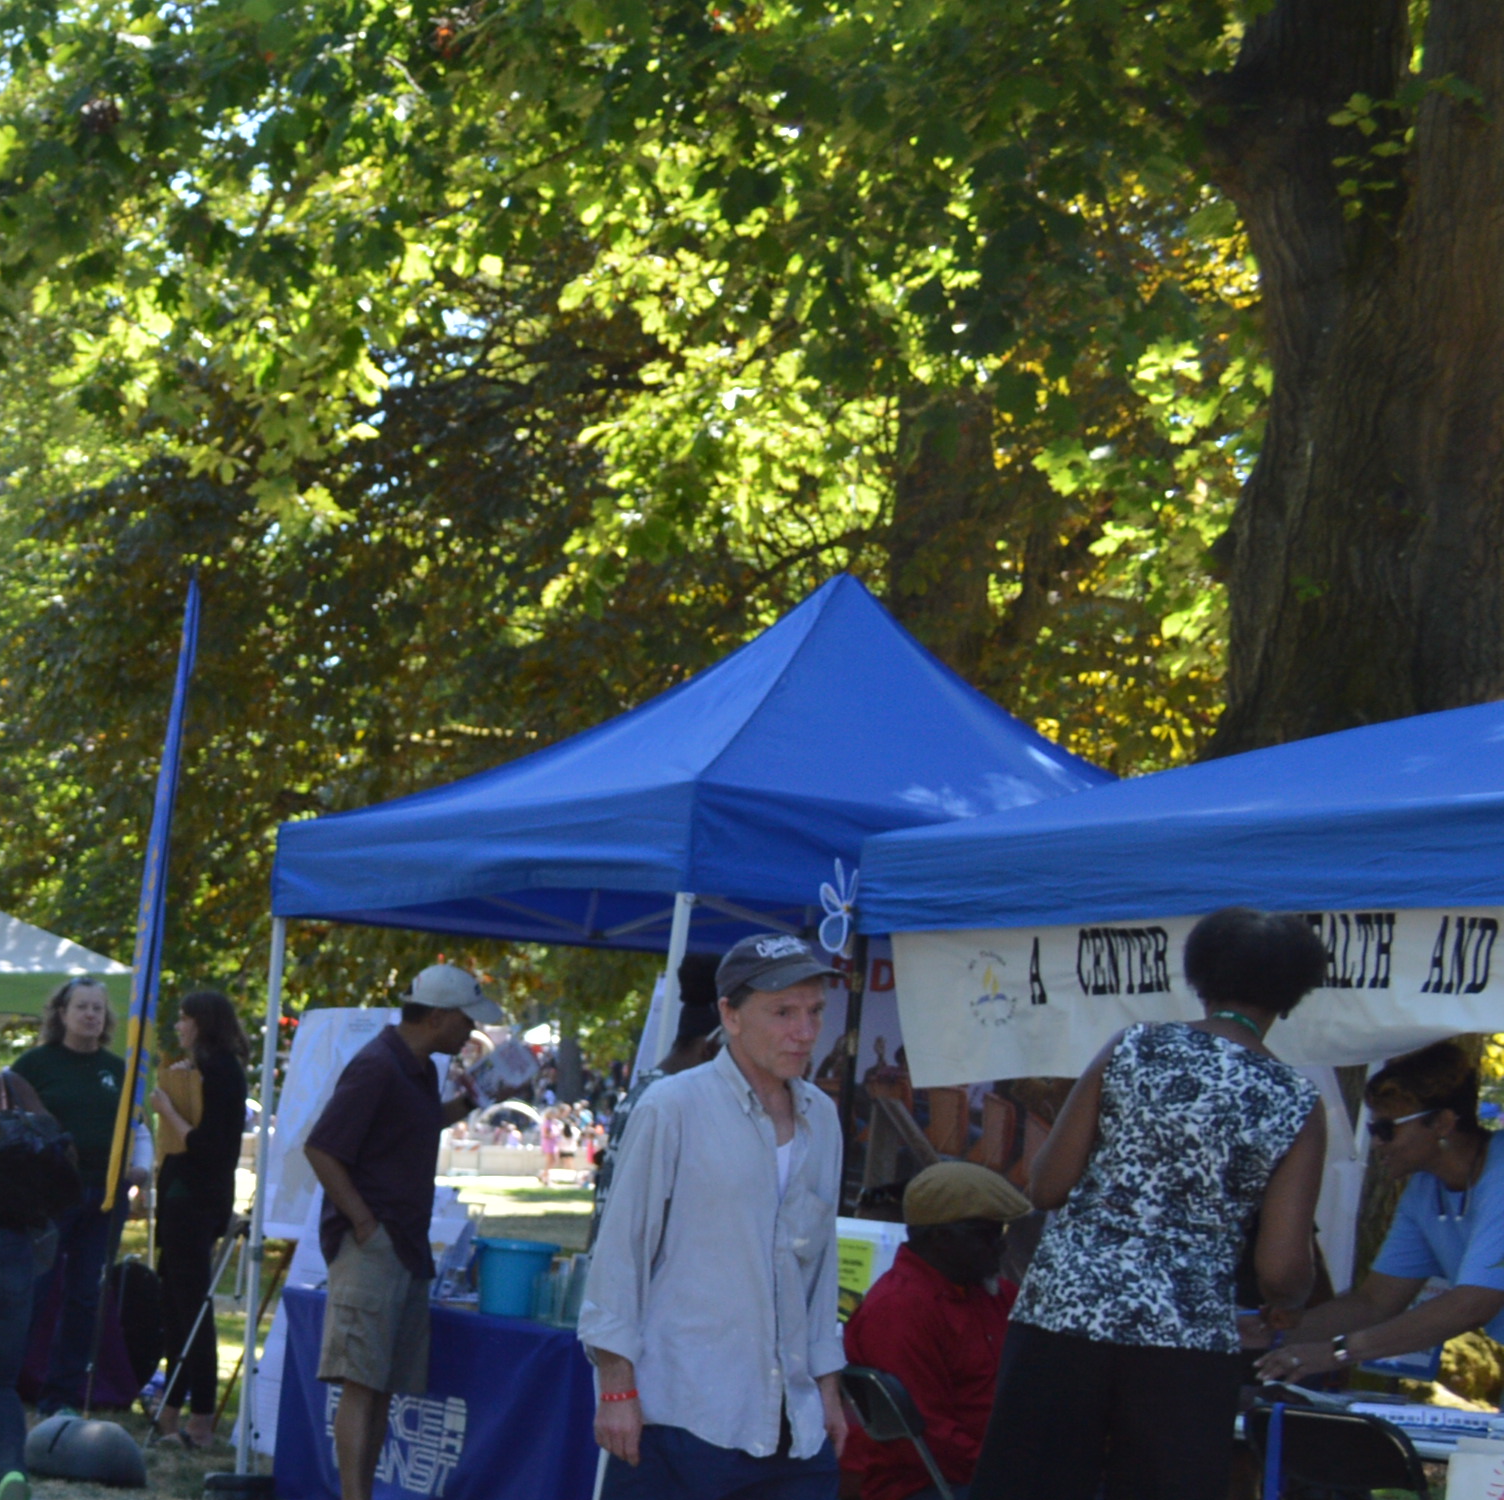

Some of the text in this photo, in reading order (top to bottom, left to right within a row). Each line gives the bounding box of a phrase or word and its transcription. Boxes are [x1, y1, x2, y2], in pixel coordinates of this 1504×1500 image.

[1030, 913, 1498, 1005] A CENTER ALTH AND
